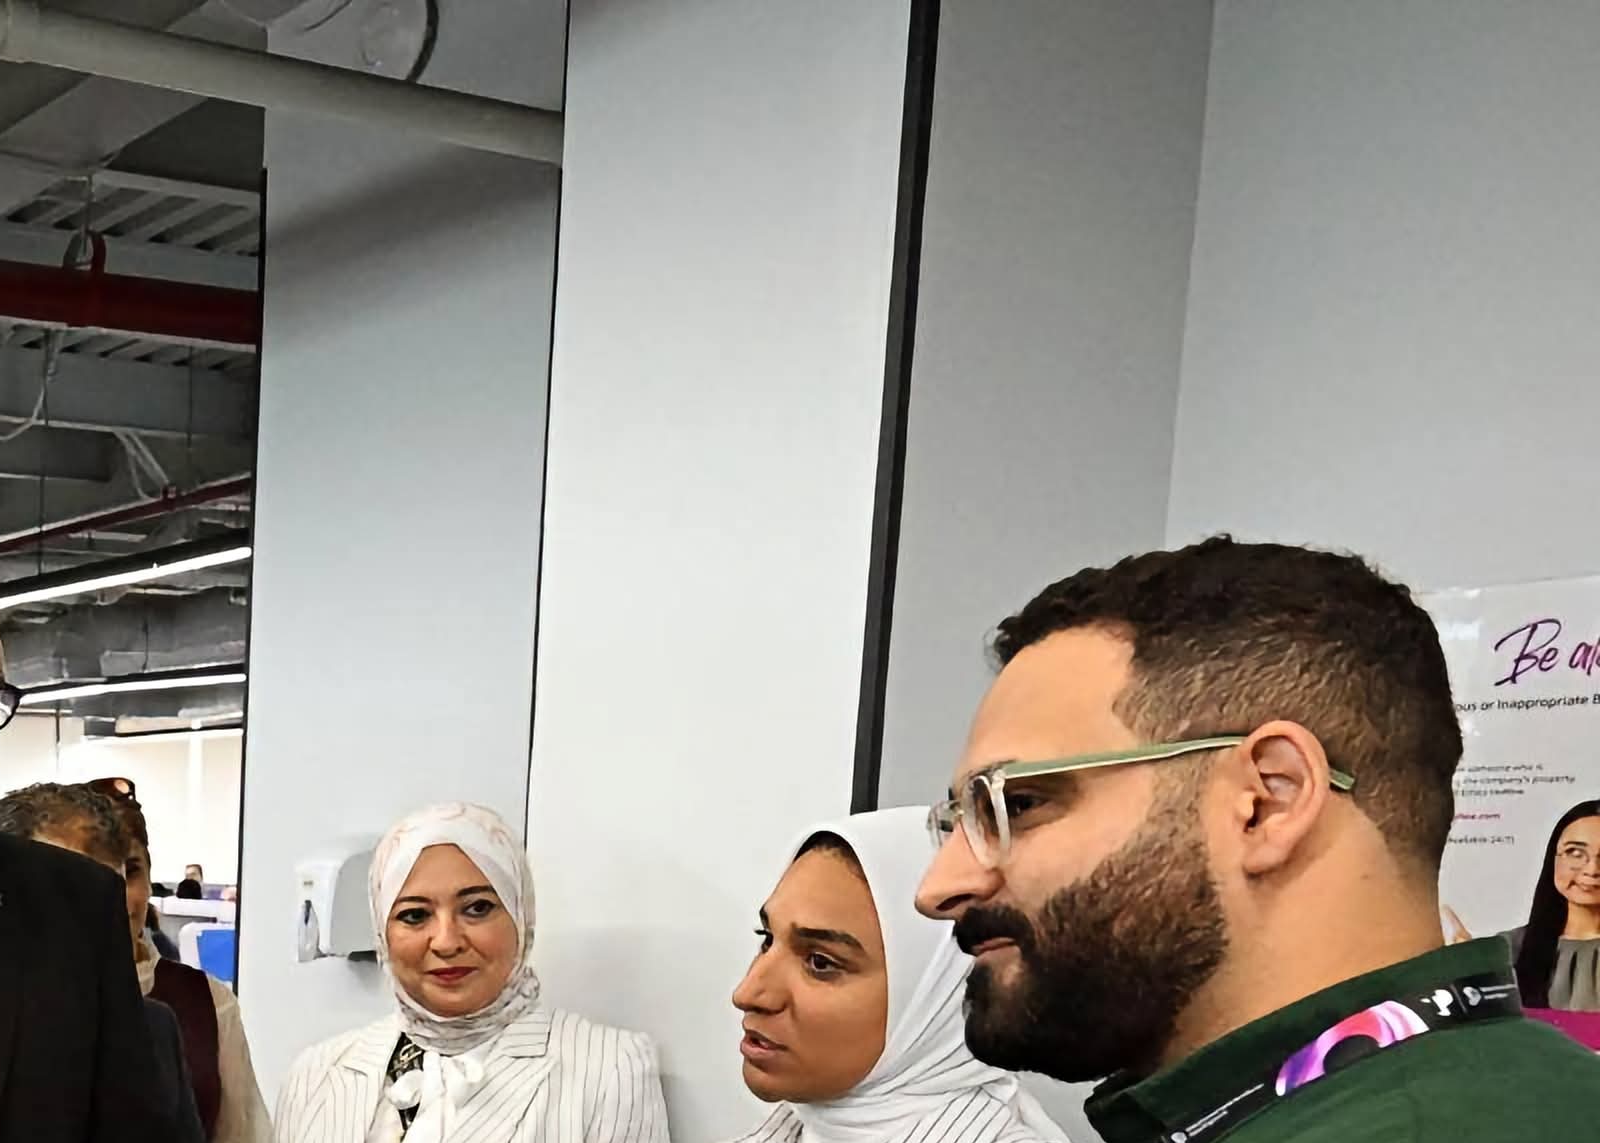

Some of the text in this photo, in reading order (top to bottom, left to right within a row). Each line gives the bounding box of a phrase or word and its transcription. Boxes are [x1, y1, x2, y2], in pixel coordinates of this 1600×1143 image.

[1494, 618, 1561, 686] Be
[1481, 701, 1495, 711] or
[1497, 695, 1589, 710] Inappropriate
